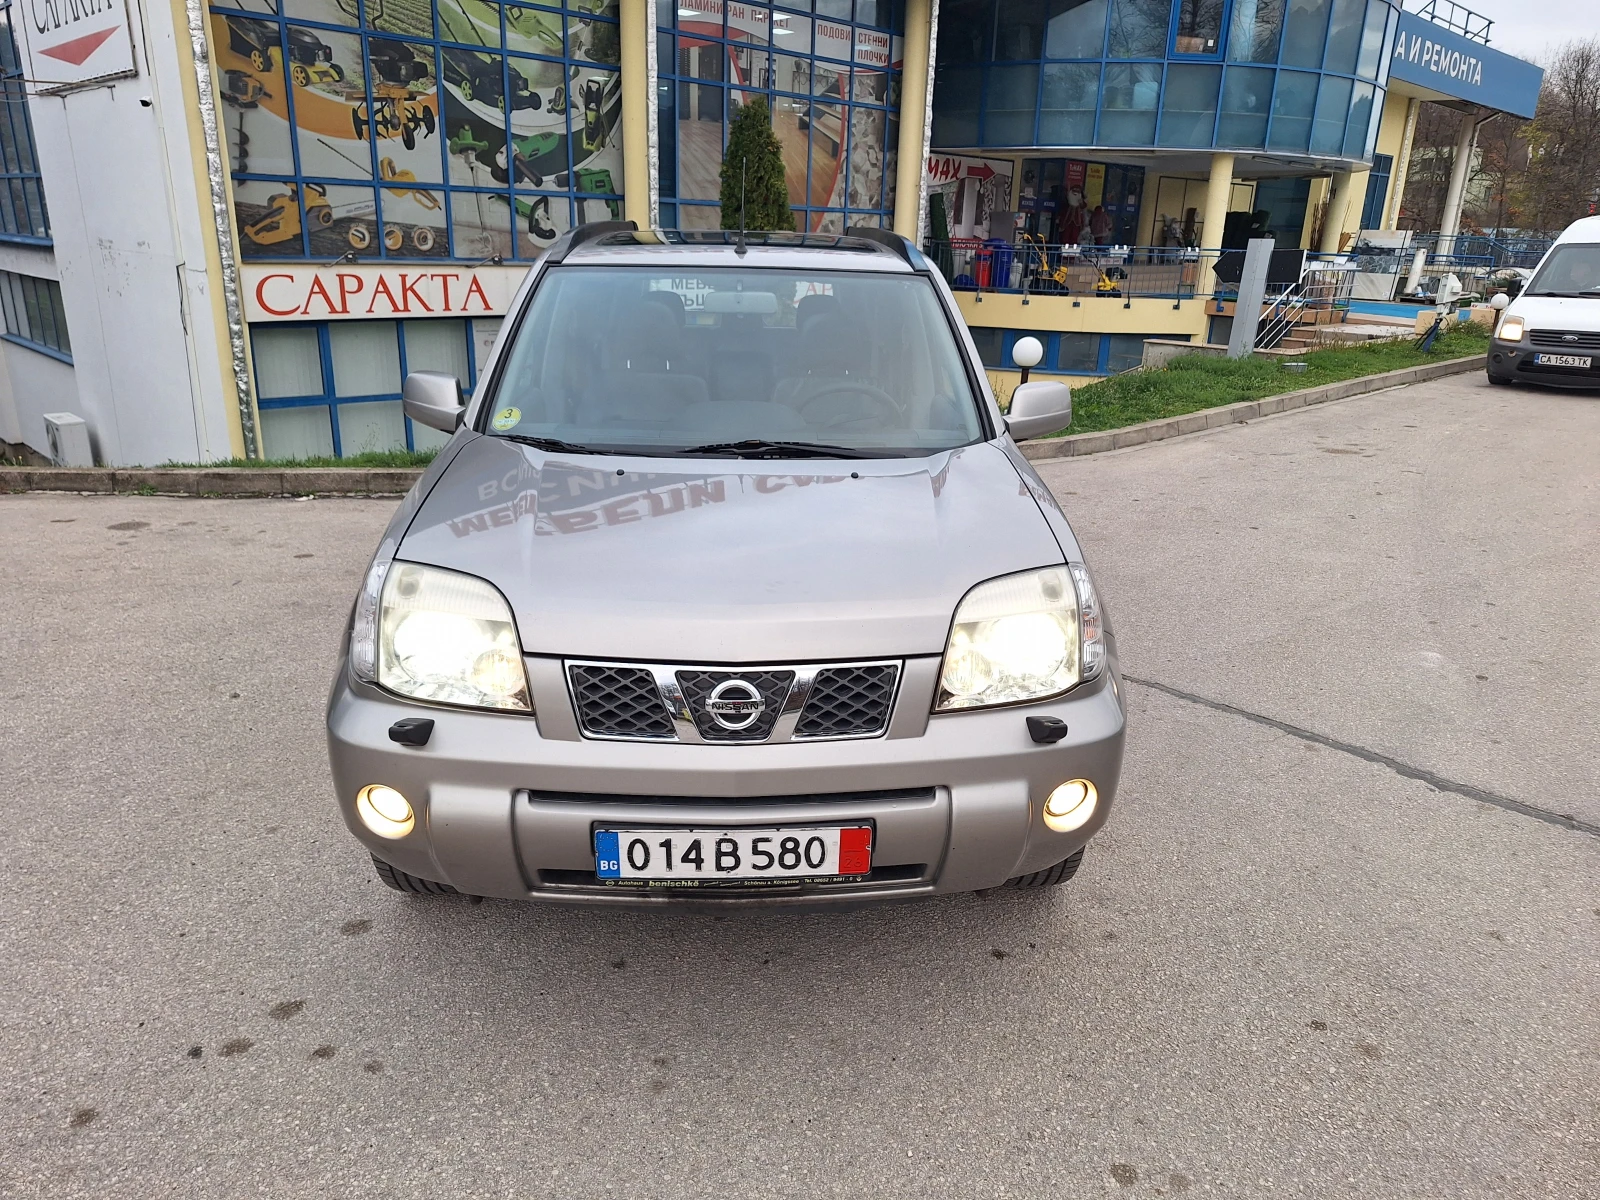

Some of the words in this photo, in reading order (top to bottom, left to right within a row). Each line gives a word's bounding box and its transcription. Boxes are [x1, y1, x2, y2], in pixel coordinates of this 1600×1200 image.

[817, 23, 851, 42] ПОДОВИ
[858, 32, 888, 49] СТЕННИ
[857, 49, 889, 65] ПЛОЧКИ
[1408, 34, 1422, 64] И
[1421, 40, 1482, 86] РЕМОНТА
[255, 273, 494, 316] САРАКТА
[1555, 356, 1576, 365] 1563
[504, 408, 514, 419] 3
[711, 702, 759, 711] NISSAN
[600, 860, 618, 871] BG
